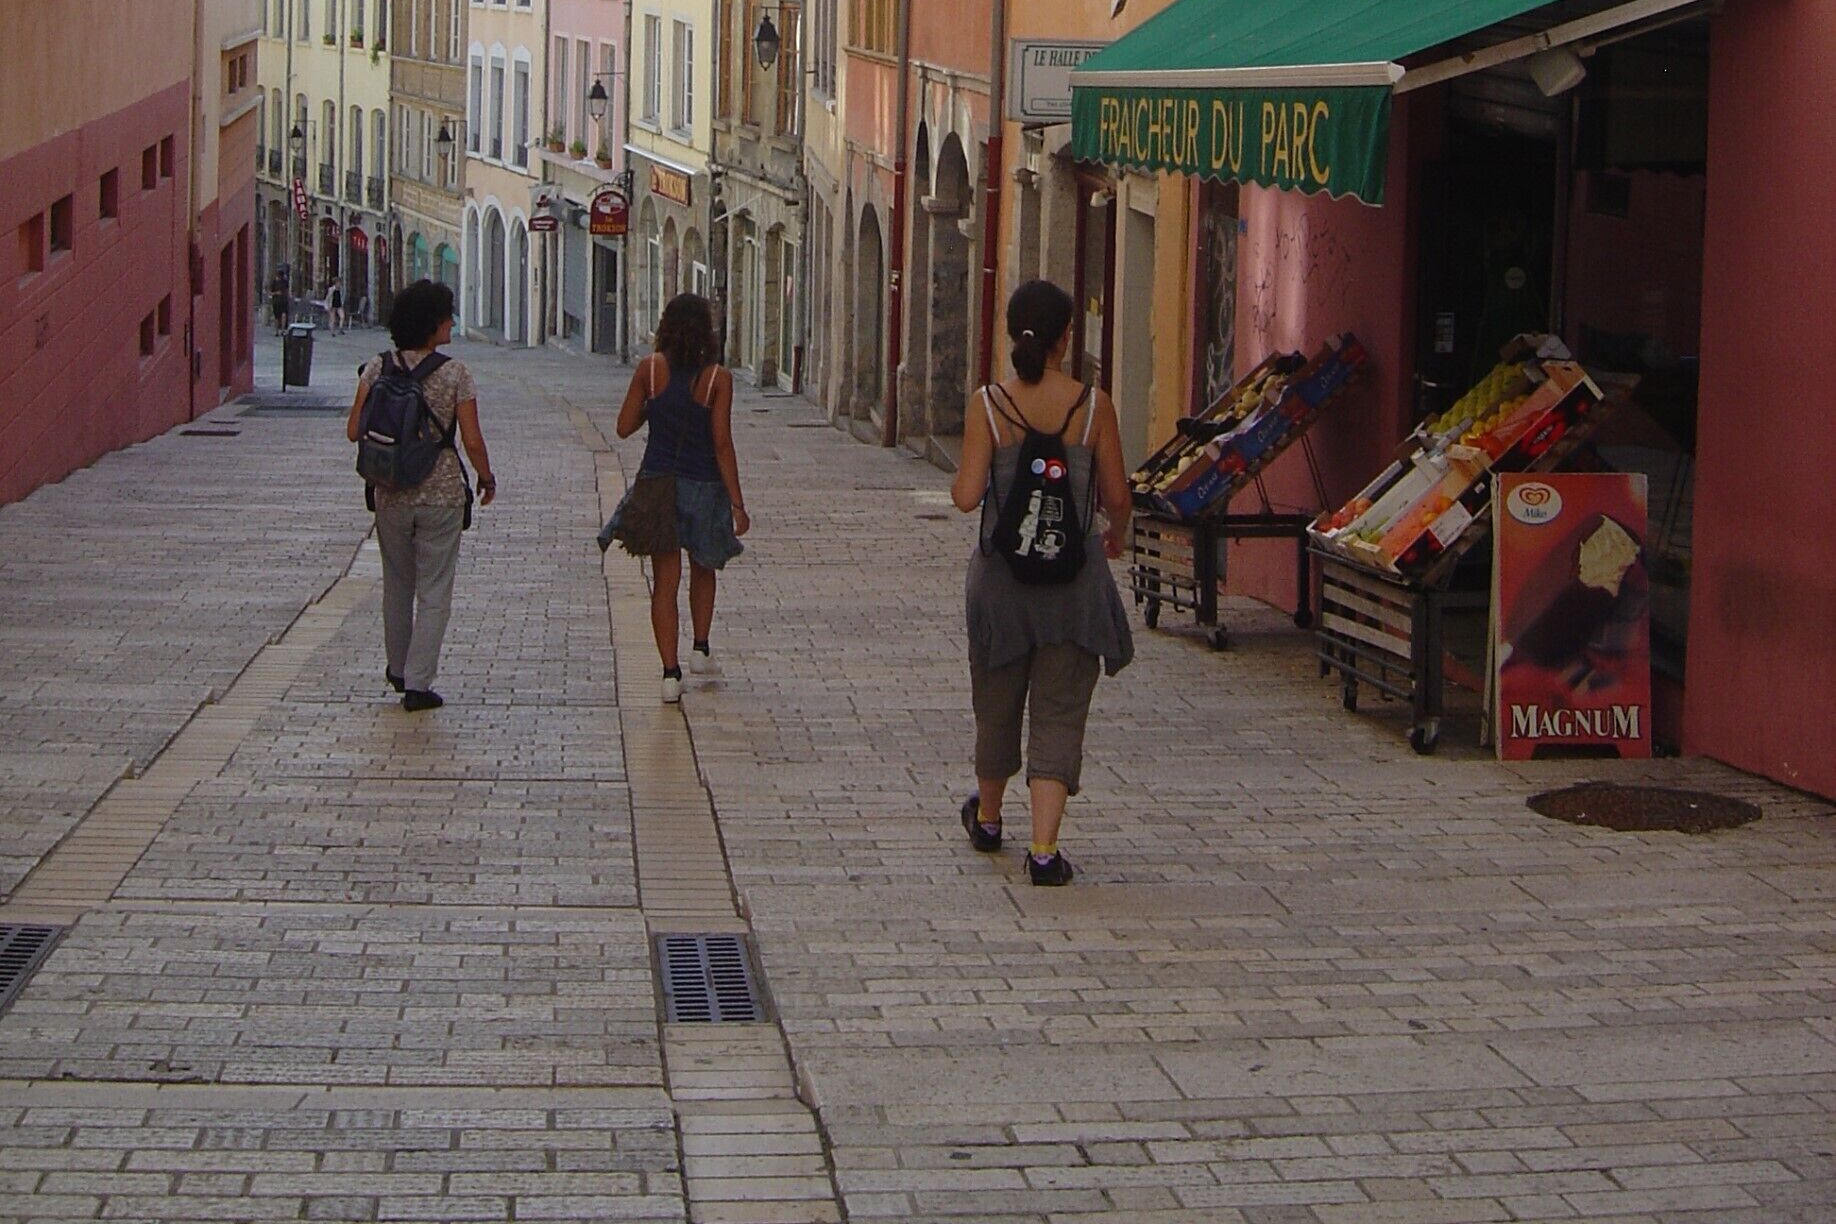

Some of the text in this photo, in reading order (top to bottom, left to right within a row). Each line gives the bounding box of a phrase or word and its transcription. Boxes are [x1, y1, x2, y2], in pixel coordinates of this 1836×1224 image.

[1034, 49, 1047, 66] LE
[1049, 50, 1080, 67] HALLE
[1099, 97, 1331, 185] FRAICHEUR DU PARC
[295, 178, 308, 219] TABAC
[1511, 704, 1640, 739] MAGNUM
